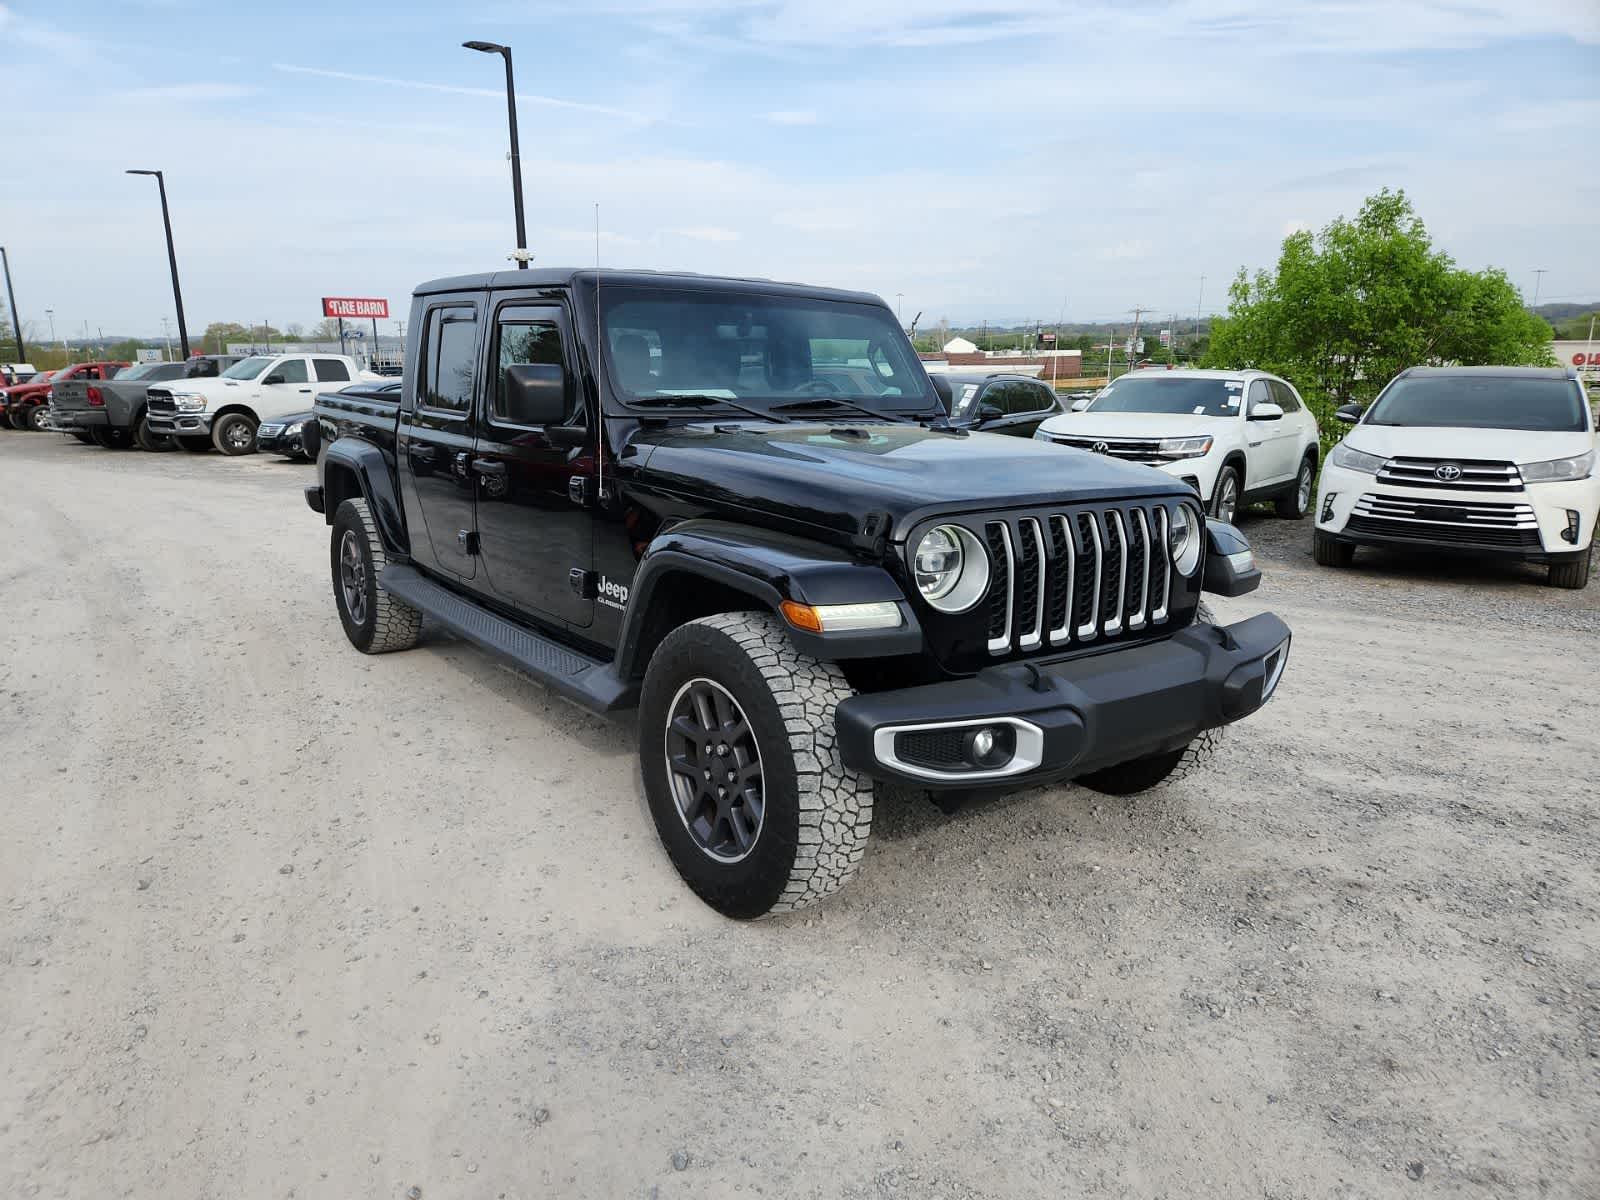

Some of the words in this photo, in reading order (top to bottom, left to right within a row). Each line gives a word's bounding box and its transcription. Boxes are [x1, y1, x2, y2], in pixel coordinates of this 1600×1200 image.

[328, 300, 355, 315] TIRE
[356, 301, 385, 316] BARN
[597, 575, 628, 603] Jeep
